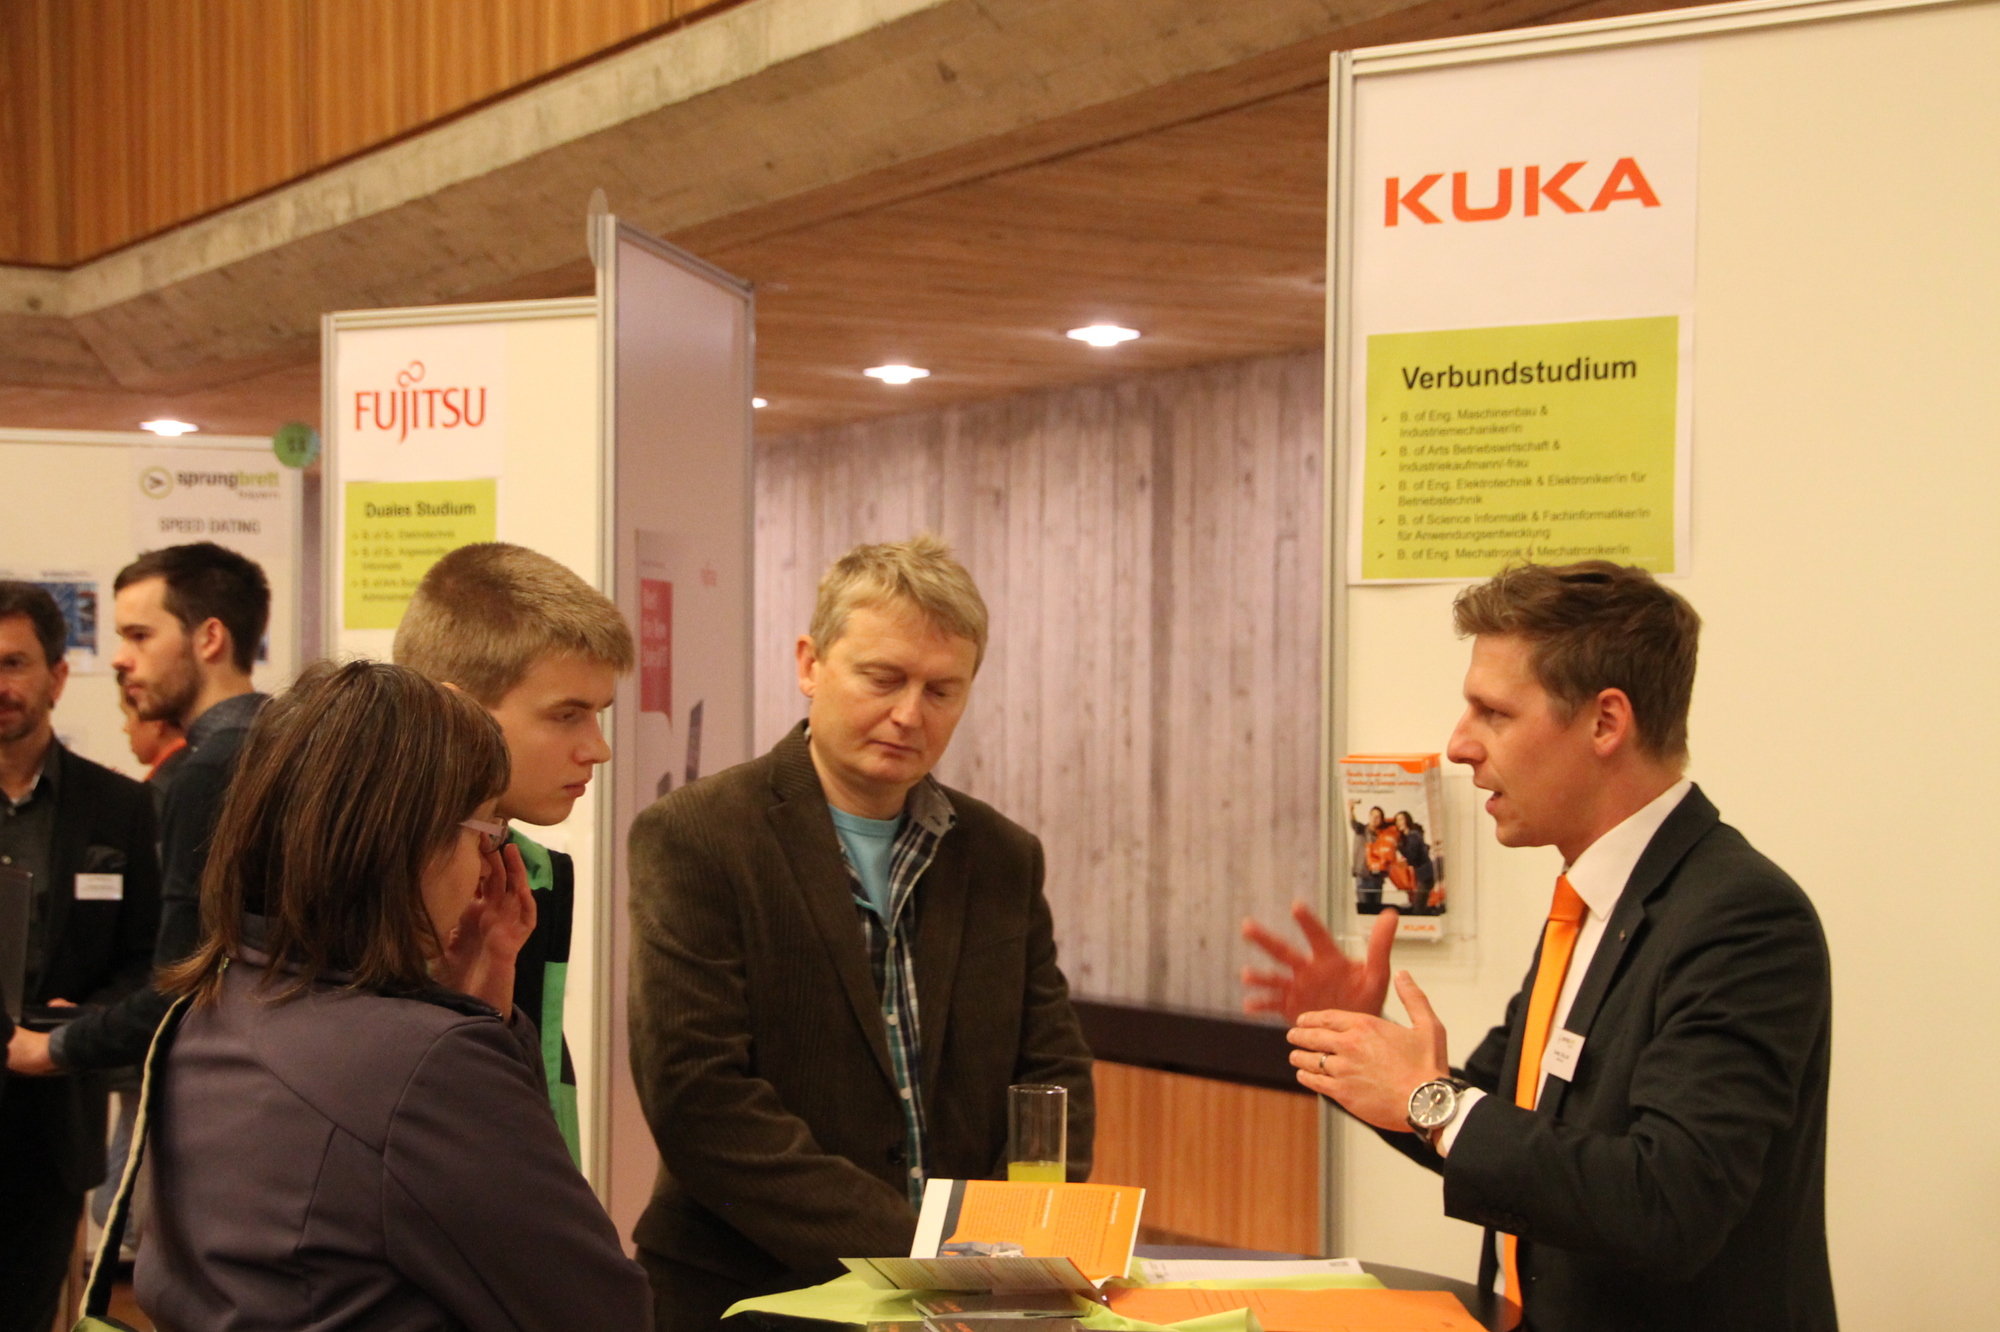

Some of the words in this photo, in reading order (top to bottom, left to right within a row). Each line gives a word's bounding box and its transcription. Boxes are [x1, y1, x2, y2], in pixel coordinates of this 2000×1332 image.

[1384, 156, 1662, 228] KUKA
[1402, 356, 1638, 390] Verbundstudium
[354, 386, 487, 445] FUJITSU
[176, 470, 280, 489] sprungbrett
[365, 501, 411, 518] Duales
[416, 500, 476, 517] Studium
[1426, 512, 1471, 525] Science
[159, 517, 206, 533] SPEED
[208, 518, 261, 534] DATING
